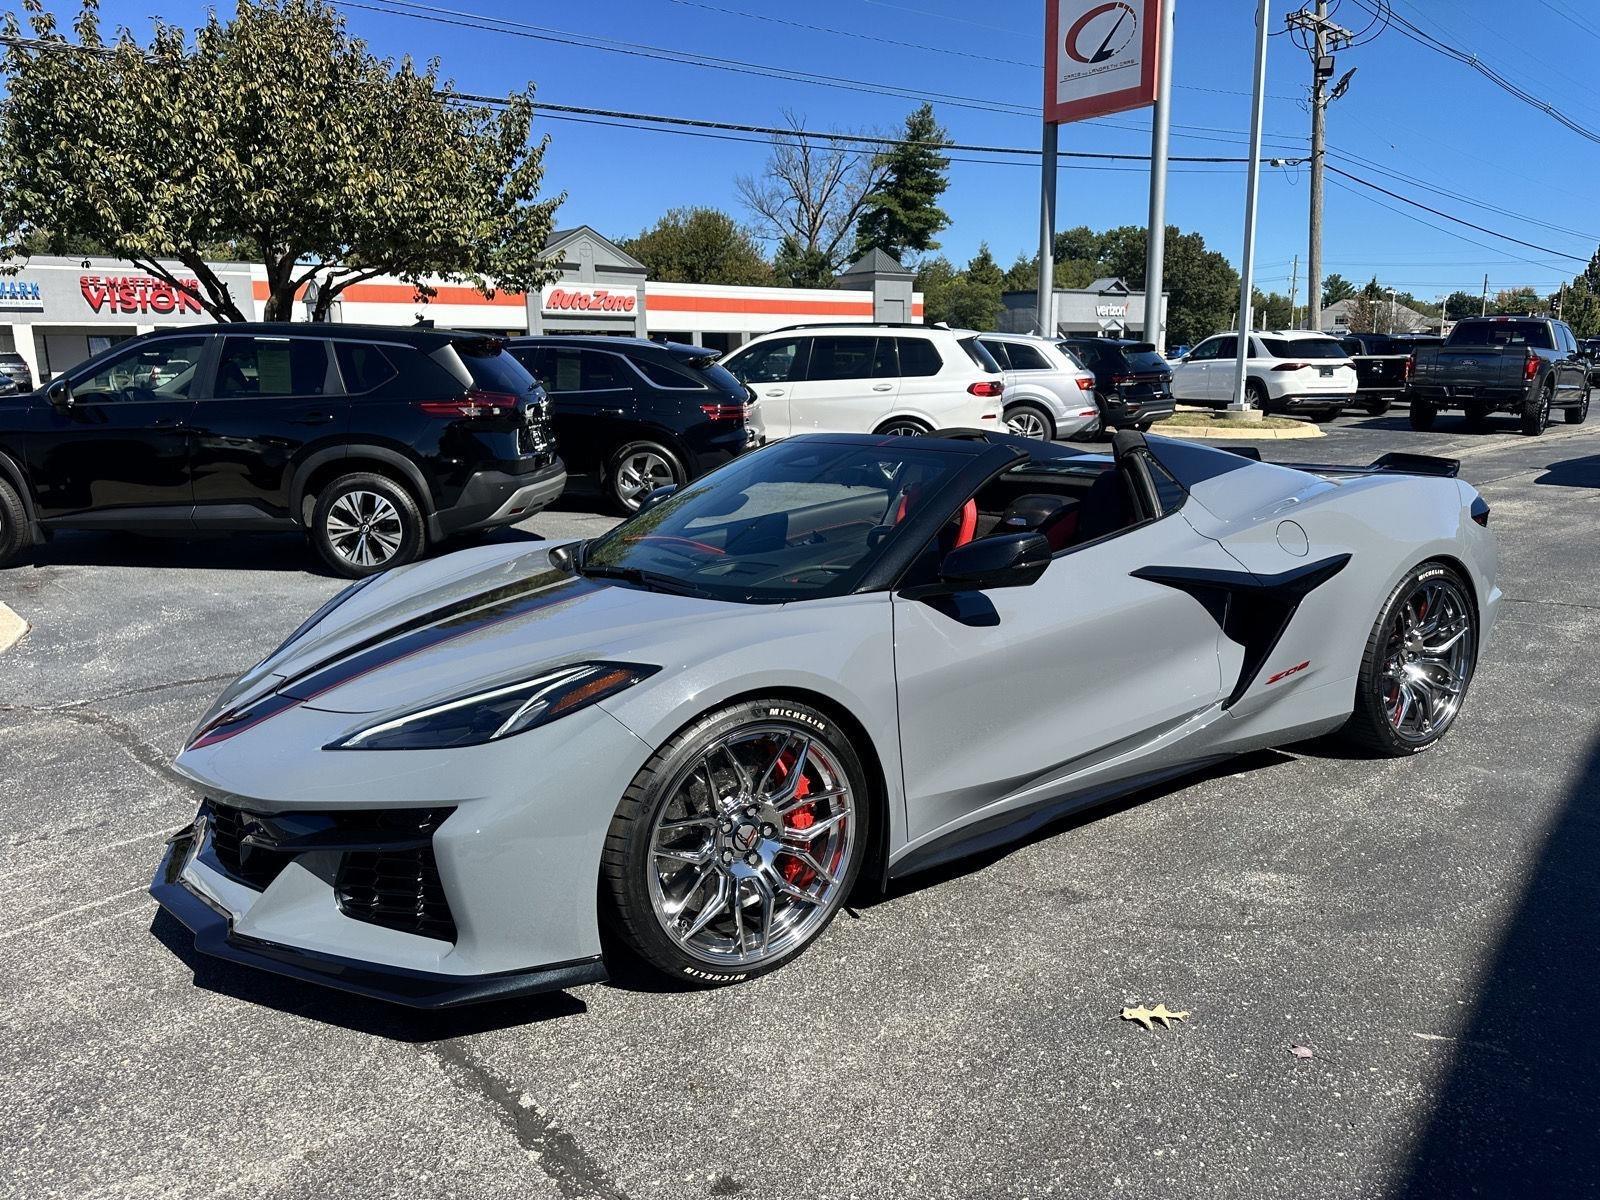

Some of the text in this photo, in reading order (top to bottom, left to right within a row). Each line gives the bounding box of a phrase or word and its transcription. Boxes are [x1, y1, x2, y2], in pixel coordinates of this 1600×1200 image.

[80, 275, 101, 290] ST
[81, 286, 202, 313] VISION
[546, 289, 635, 311] AutoZone
[1095, 302, 1126, 316] verizon
[769, 708, 826, 731] MICHELIN
[683, 966, 747, 981] MICHELIN
